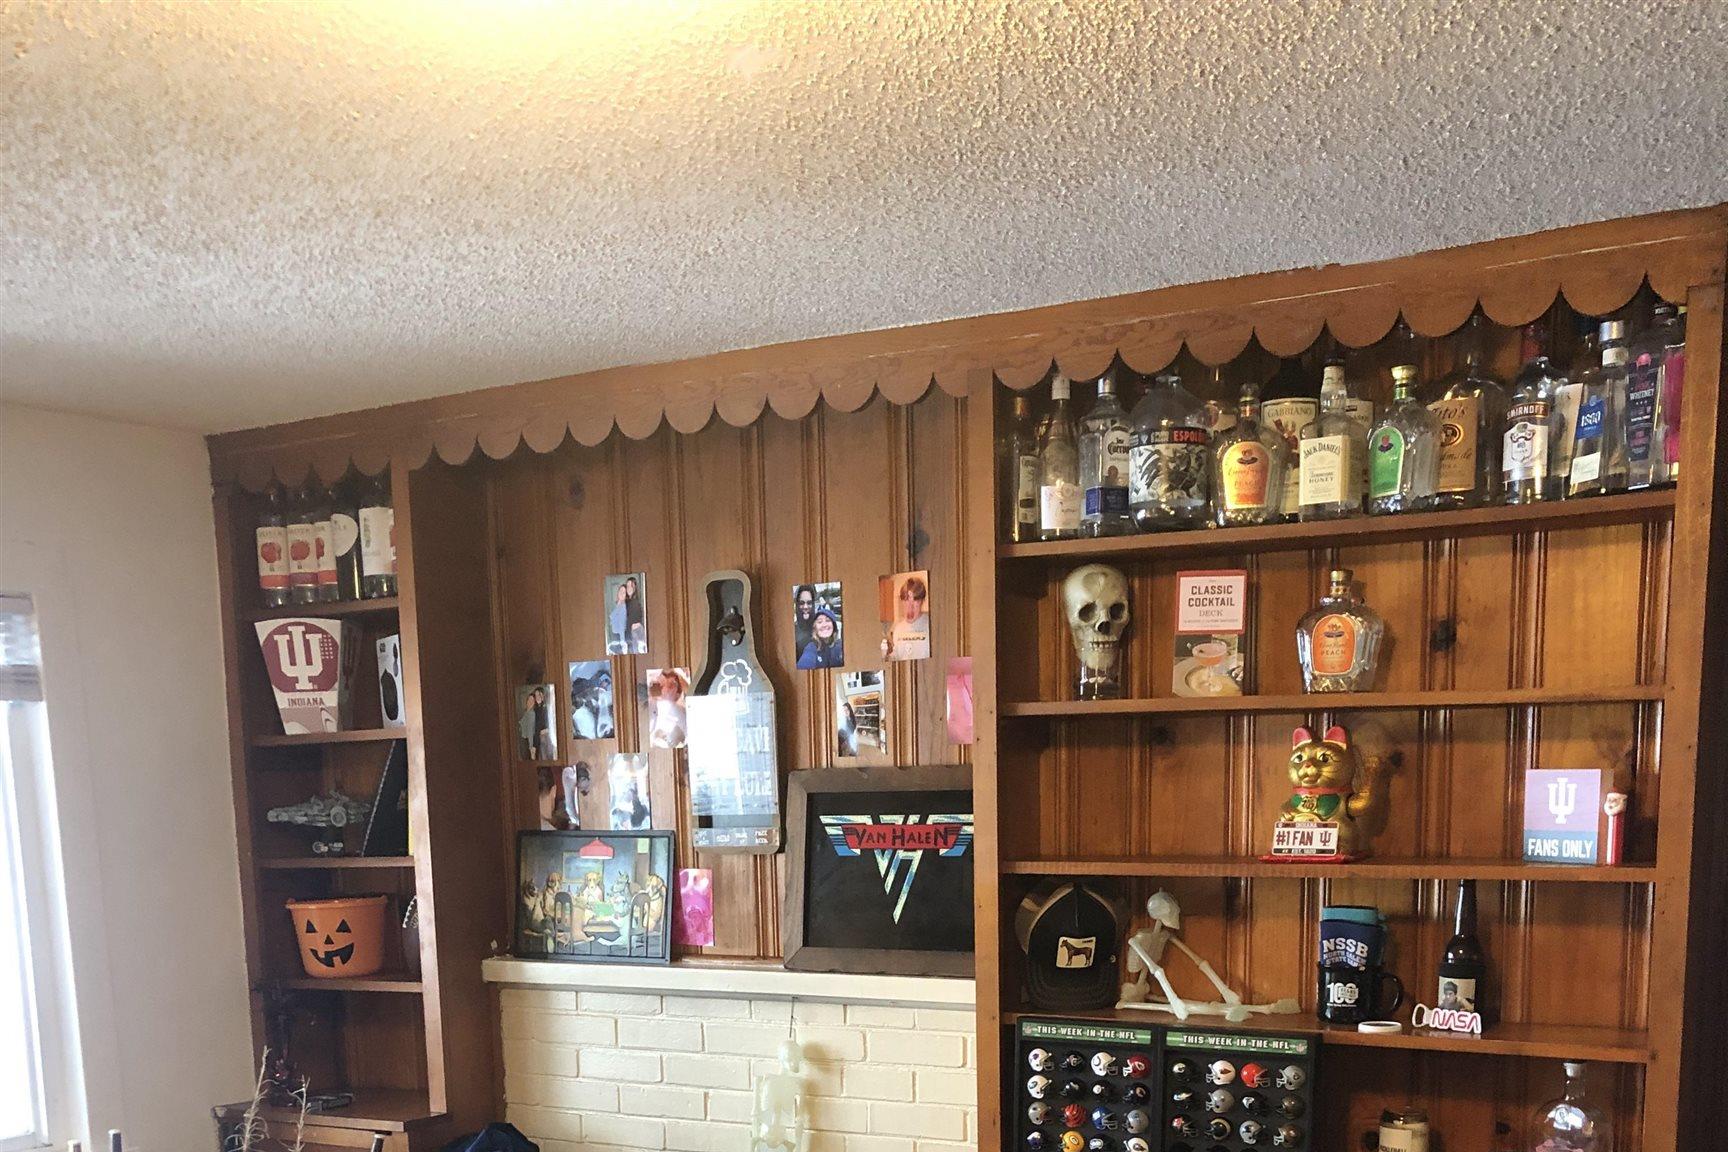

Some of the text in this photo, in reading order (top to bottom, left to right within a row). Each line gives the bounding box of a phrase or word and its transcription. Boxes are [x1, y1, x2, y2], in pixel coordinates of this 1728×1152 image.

[1630, 388, 1655, 400] WHITNEY
[1267, 406, 1313, 418] GABBIANO
[1507, 405, 1545, 420] SMIRNOFF
[1303, 445, 1318, 459] JACK
[1191, 585, 1233, 595] CLASSIC
[1188, 597, 1235, 607] COCKTAIL
[1199, 609, 1223, 617] DECK
[287, 697, 324, 707] INDIANA
[854, 828, 949, 846] VAN HALEN
[1276, 830, 1291, 846] #1
[1292, 830, 1314, 846] FAN
[1527, 838, 1594, 858] FANS ONLY
[1322, 937, 1369, 957] NSSB
[1431, 1008, 1481, 1034] NASA
[1037, 1025, 1135, 1039] THIS WEEK IN THE NFL
[1183, 1035, 1290, 1049] THIS WEEK IN THE NFL
